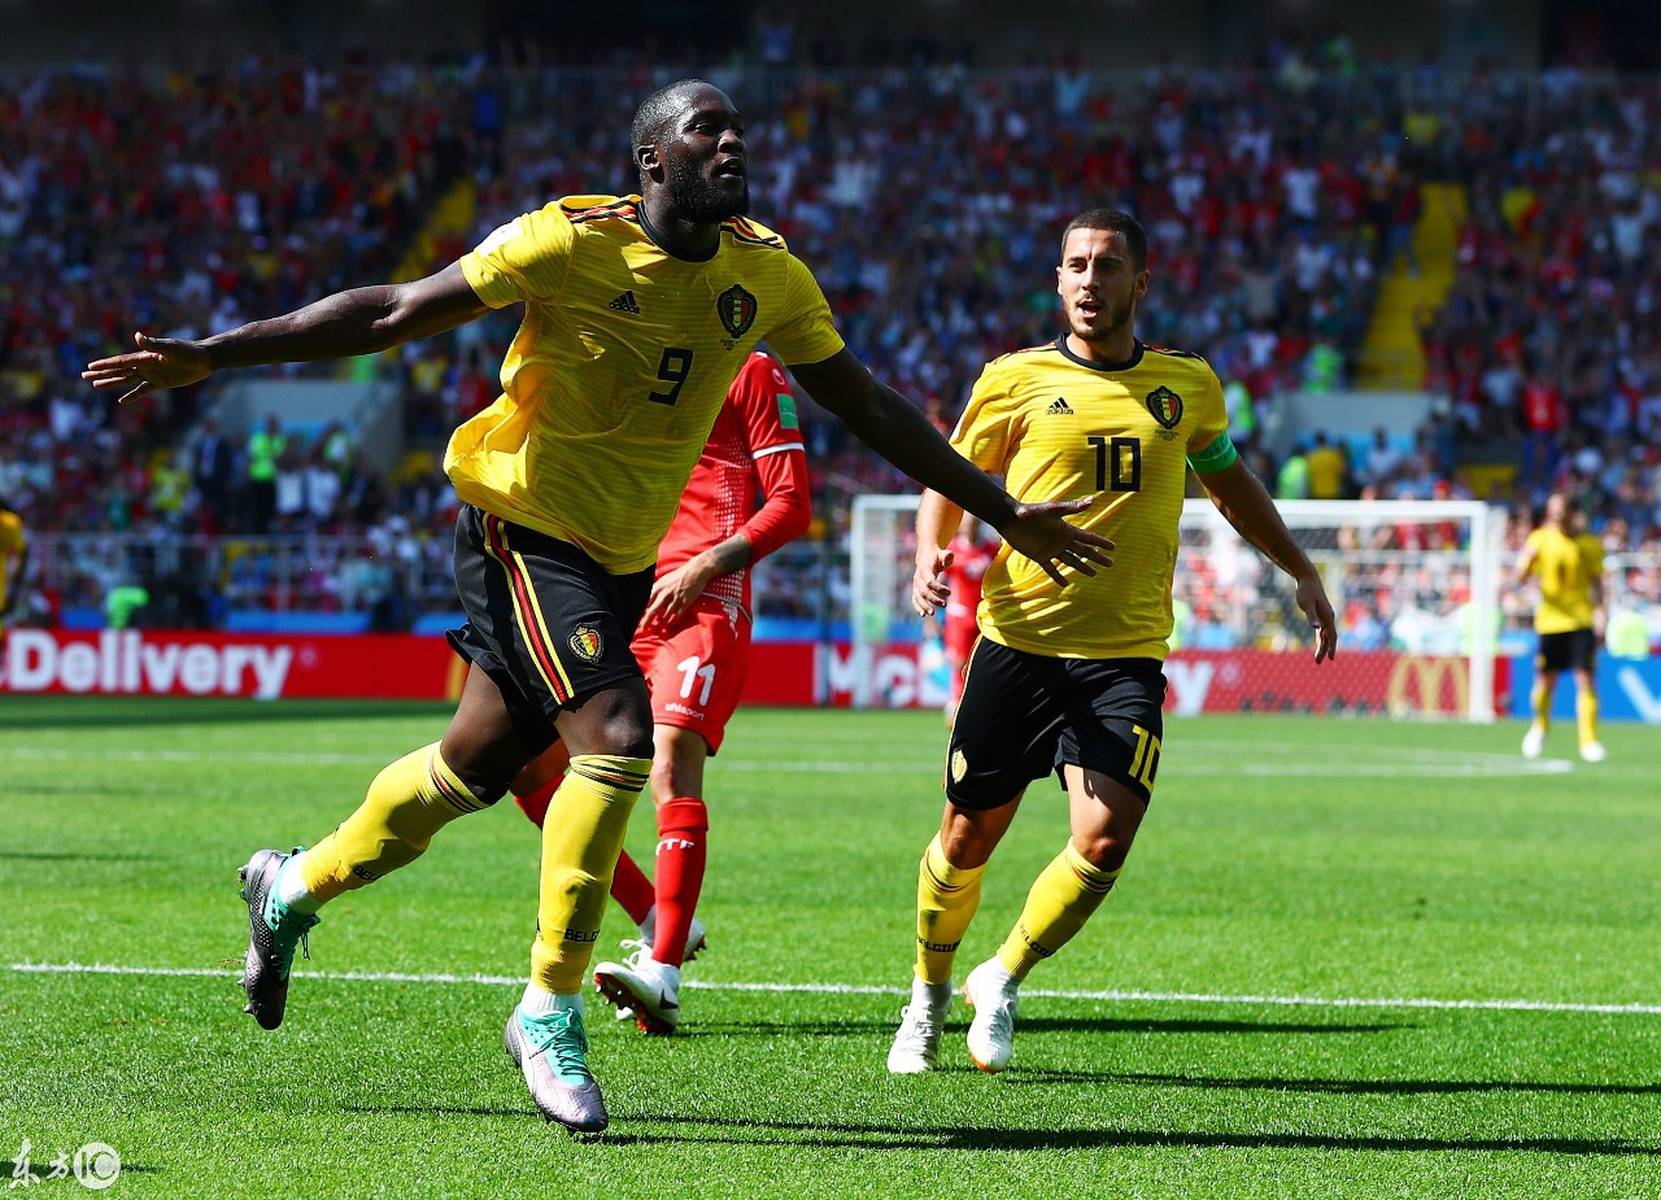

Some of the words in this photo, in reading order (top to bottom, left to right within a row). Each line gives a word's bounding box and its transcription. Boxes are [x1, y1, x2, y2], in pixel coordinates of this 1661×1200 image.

[649, 347, 694, 406] 9
[1087, 436, 1142, 492] 10
[0, 630, 292, 700] Delivery
[676, 655, 716, 706] 11
[1128, 723, 1163, 793] 10
